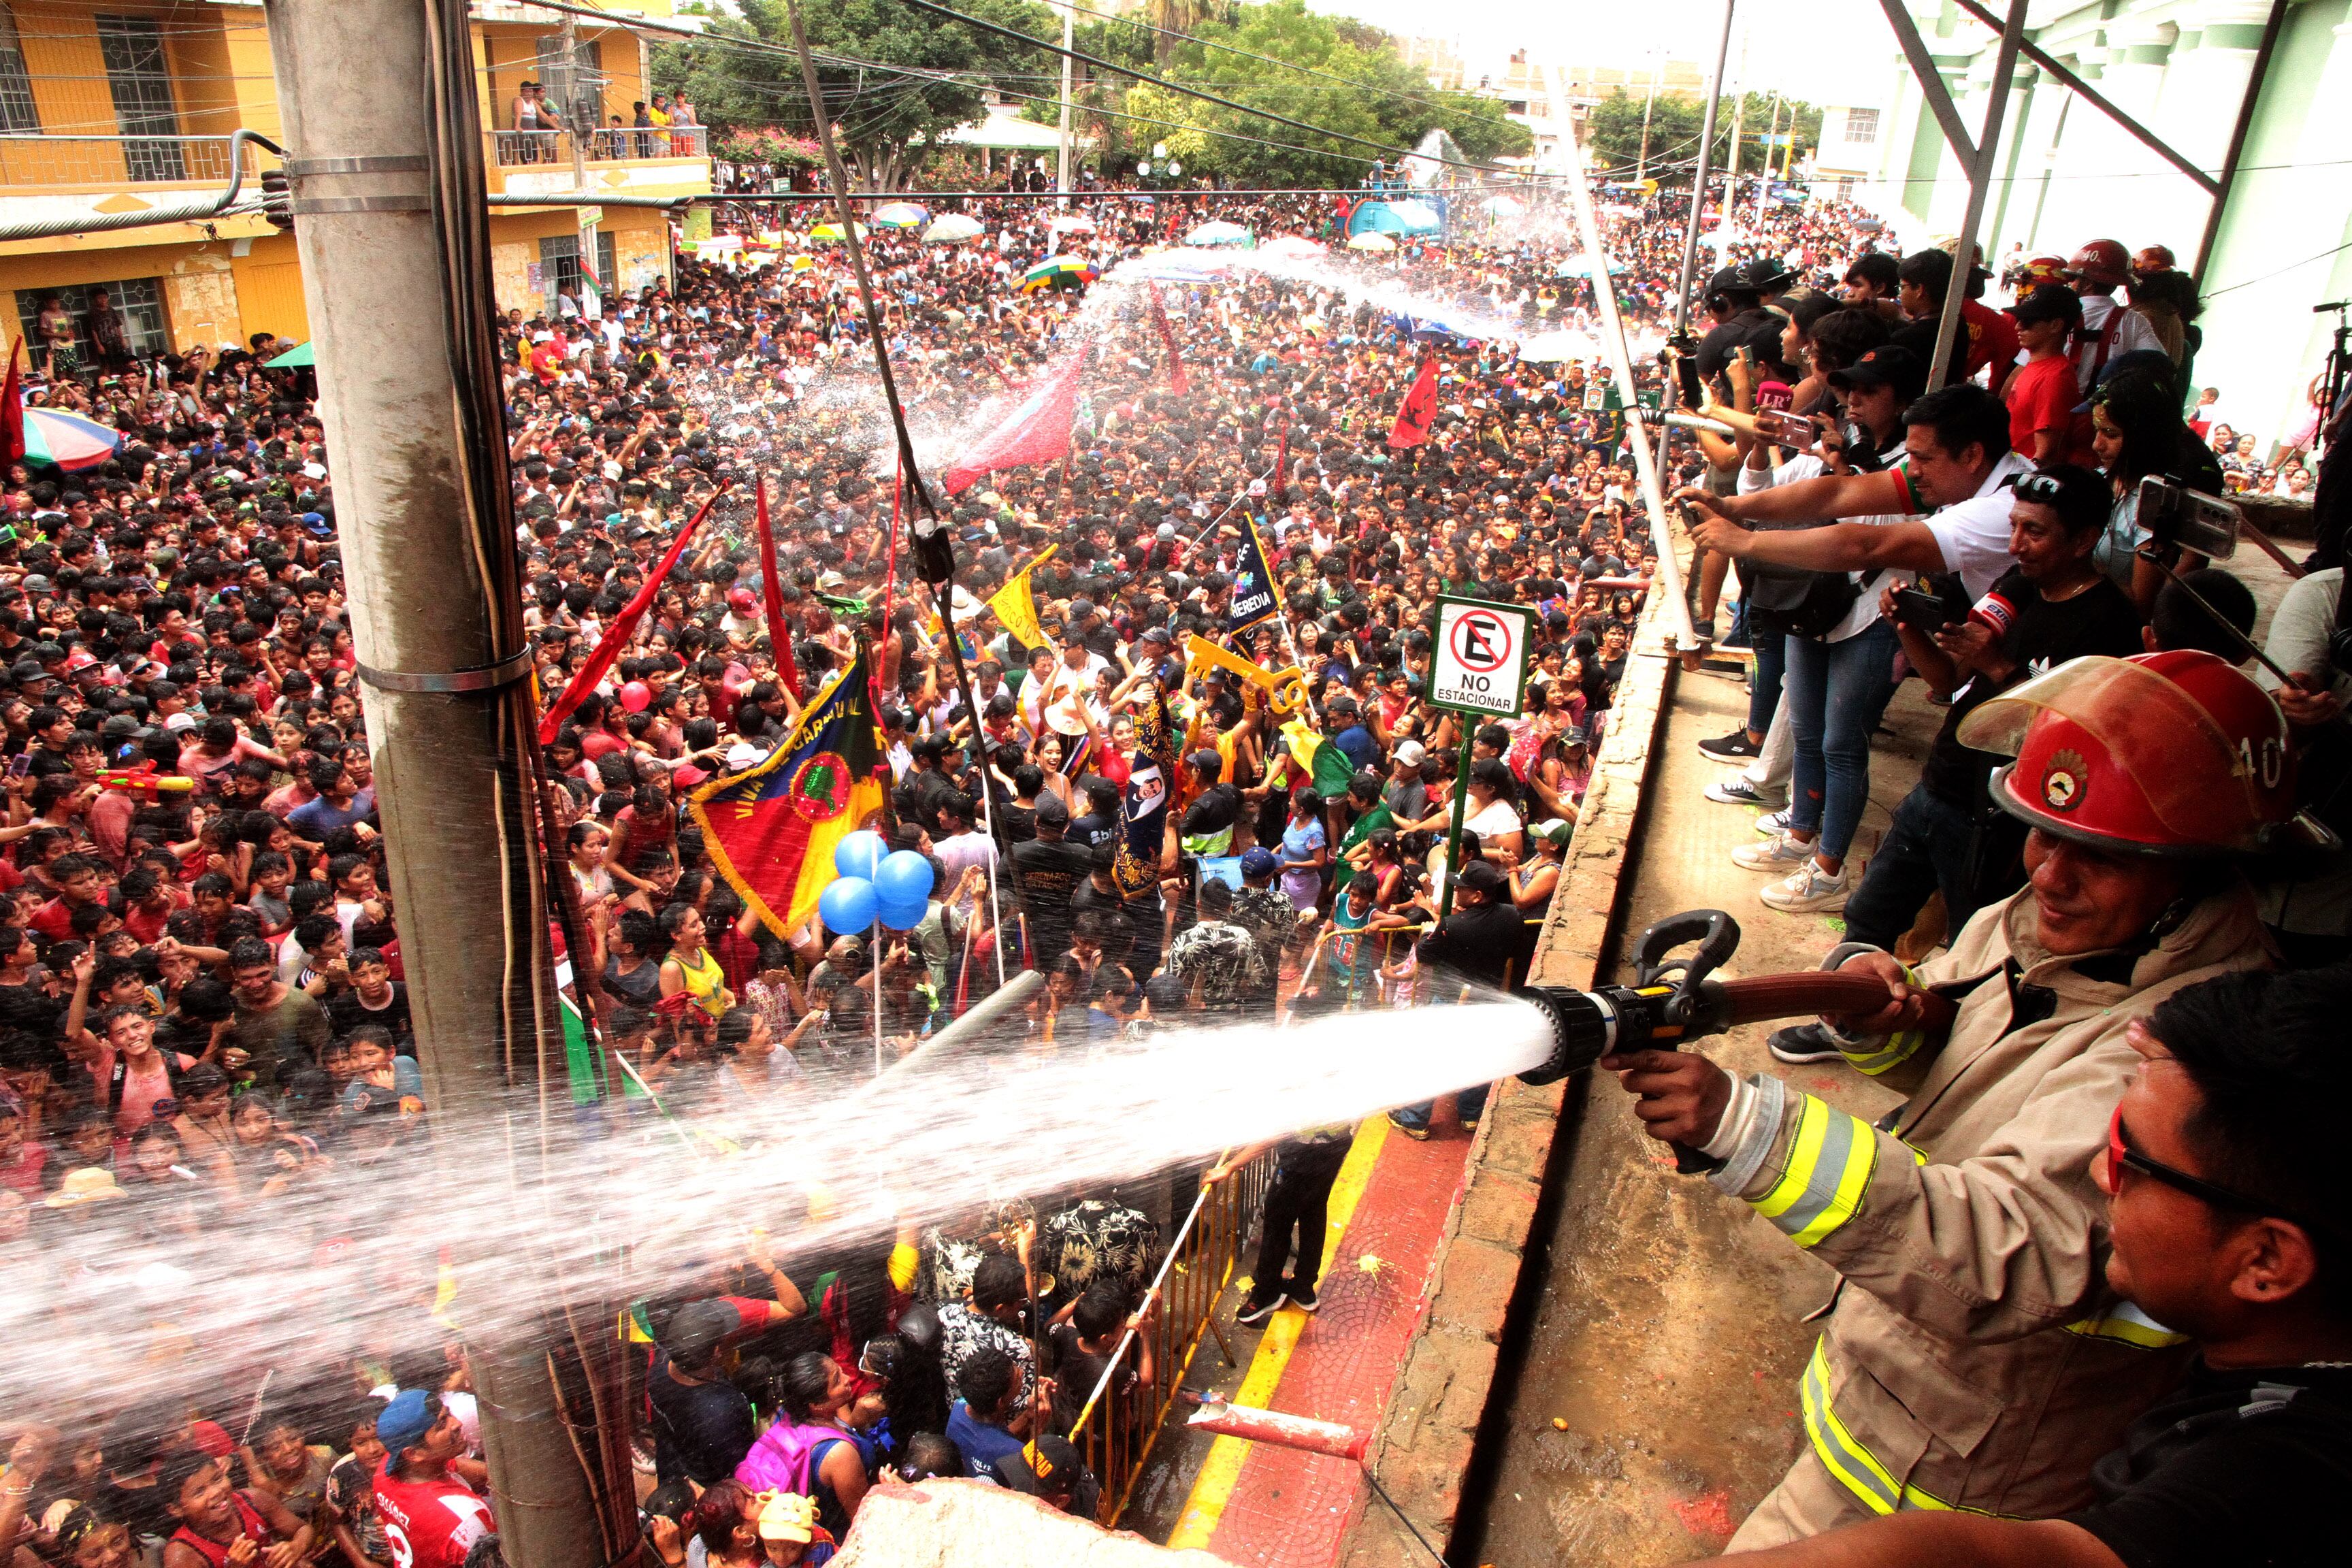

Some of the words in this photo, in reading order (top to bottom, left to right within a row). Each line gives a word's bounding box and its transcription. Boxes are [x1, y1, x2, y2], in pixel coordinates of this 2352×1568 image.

[1231, 591, 1271, 619] HEREDIA
[1461, 674, 1490, 693] NO
[1438, 689, 1511, 710] ESTACIONAR
[2232, 737, 2281, 788] 40
[735, 780, 765, 819] VIVA
